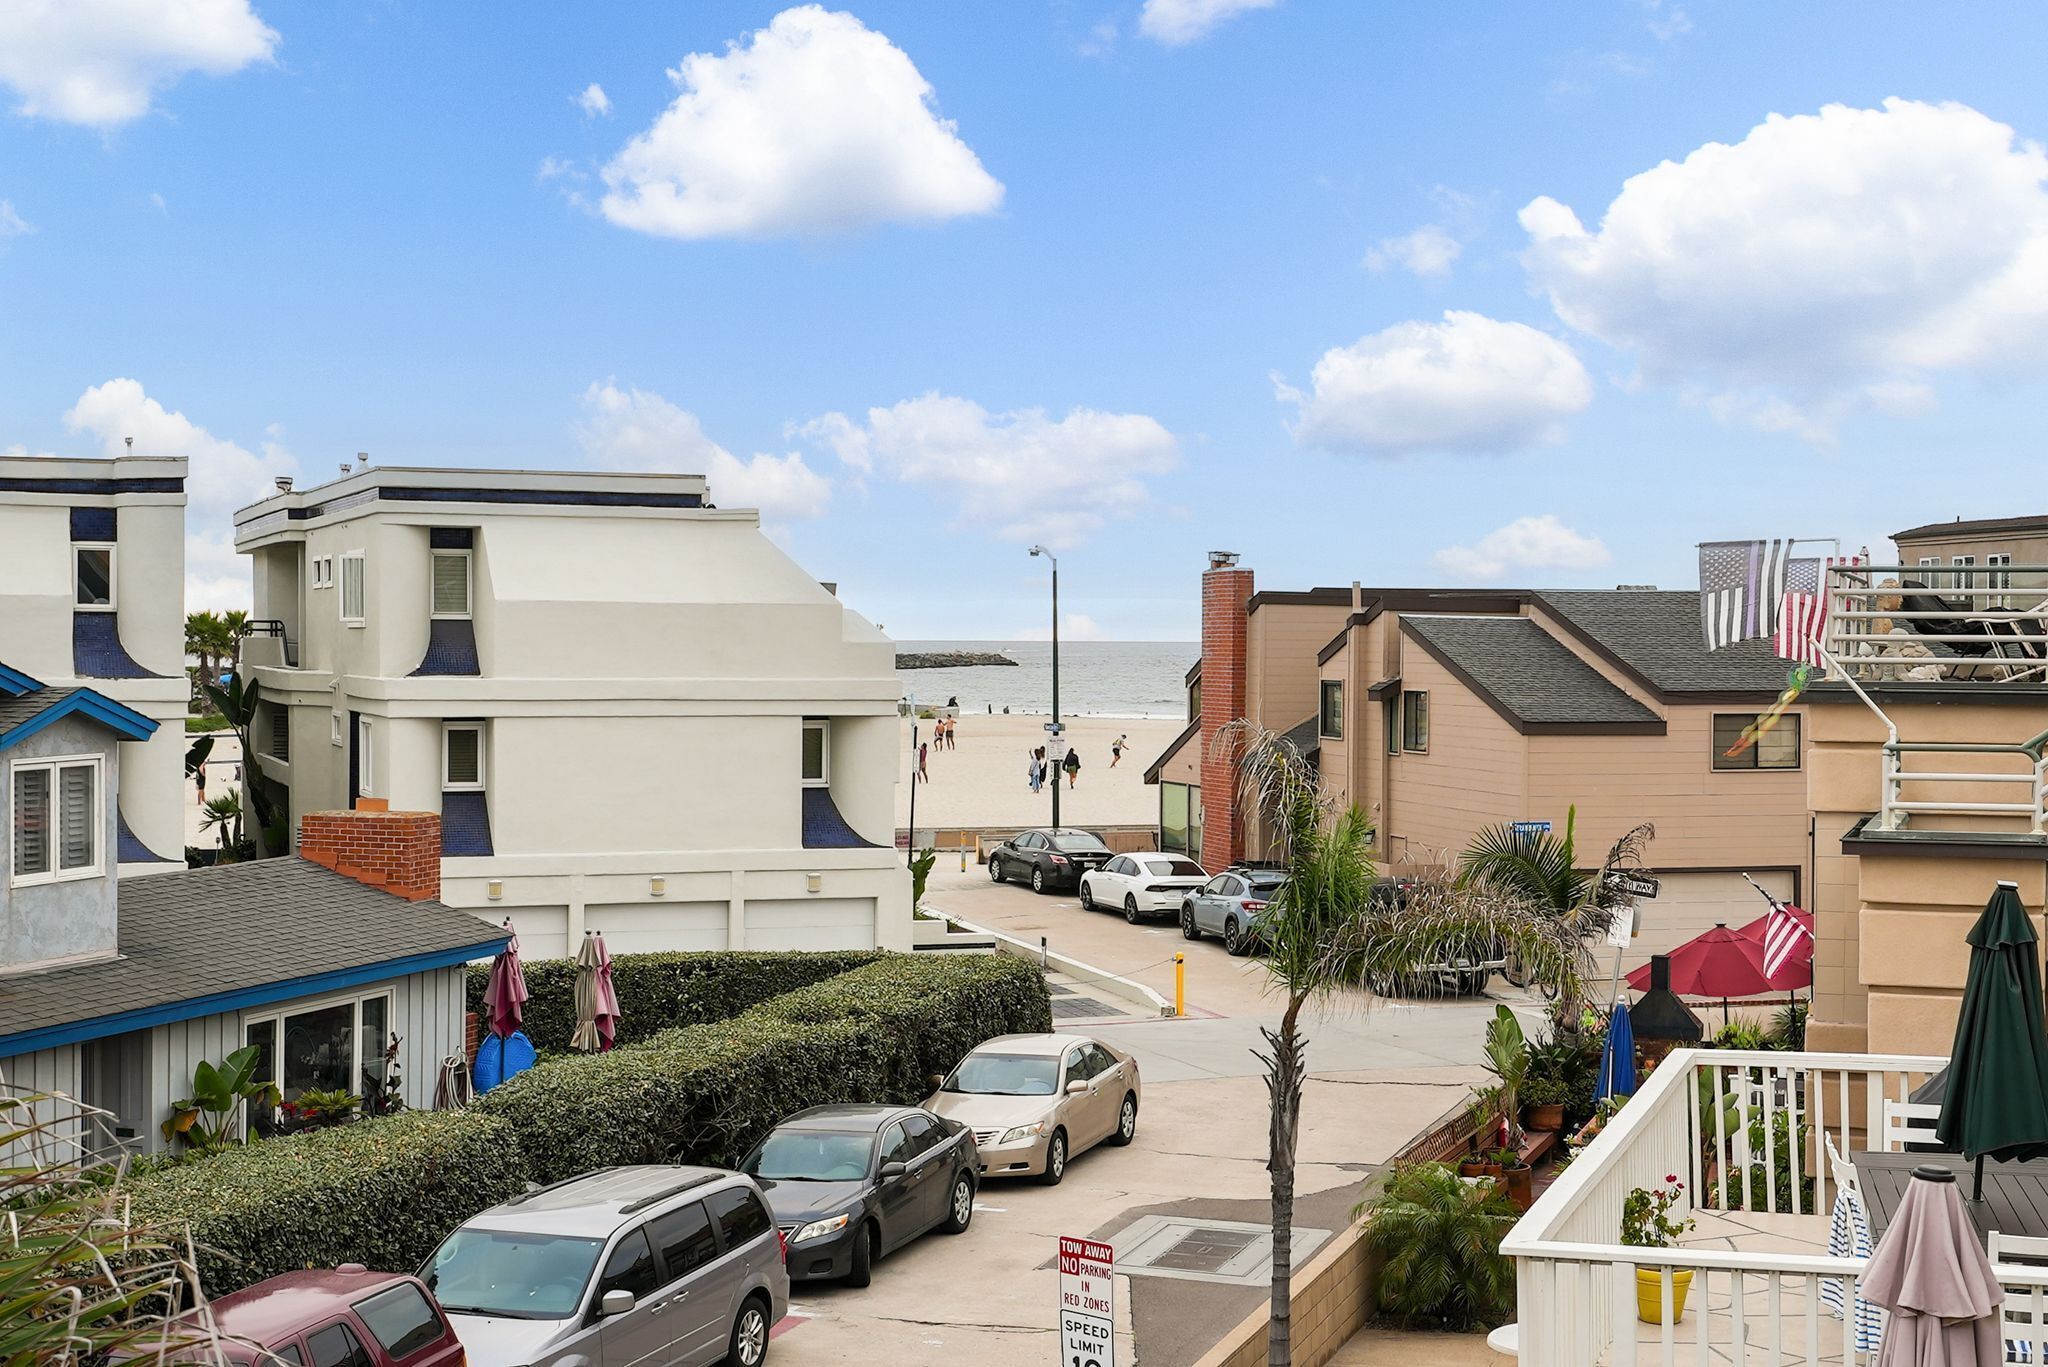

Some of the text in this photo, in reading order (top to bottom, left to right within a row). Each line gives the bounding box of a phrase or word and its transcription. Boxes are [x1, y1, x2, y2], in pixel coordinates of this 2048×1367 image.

[1061, 1240, 1111, 1260] TOW AWAY
[1061, 1256, 1111, 1280] NO PARKING
[1081, 1281, 1090, 1293] IN
[1064, 1293, 1109, 1313] RED ZONES
[1065, 1320, 1109, 1339] SPEED
[1070, 1338, 1104, 1355] LIMIT
